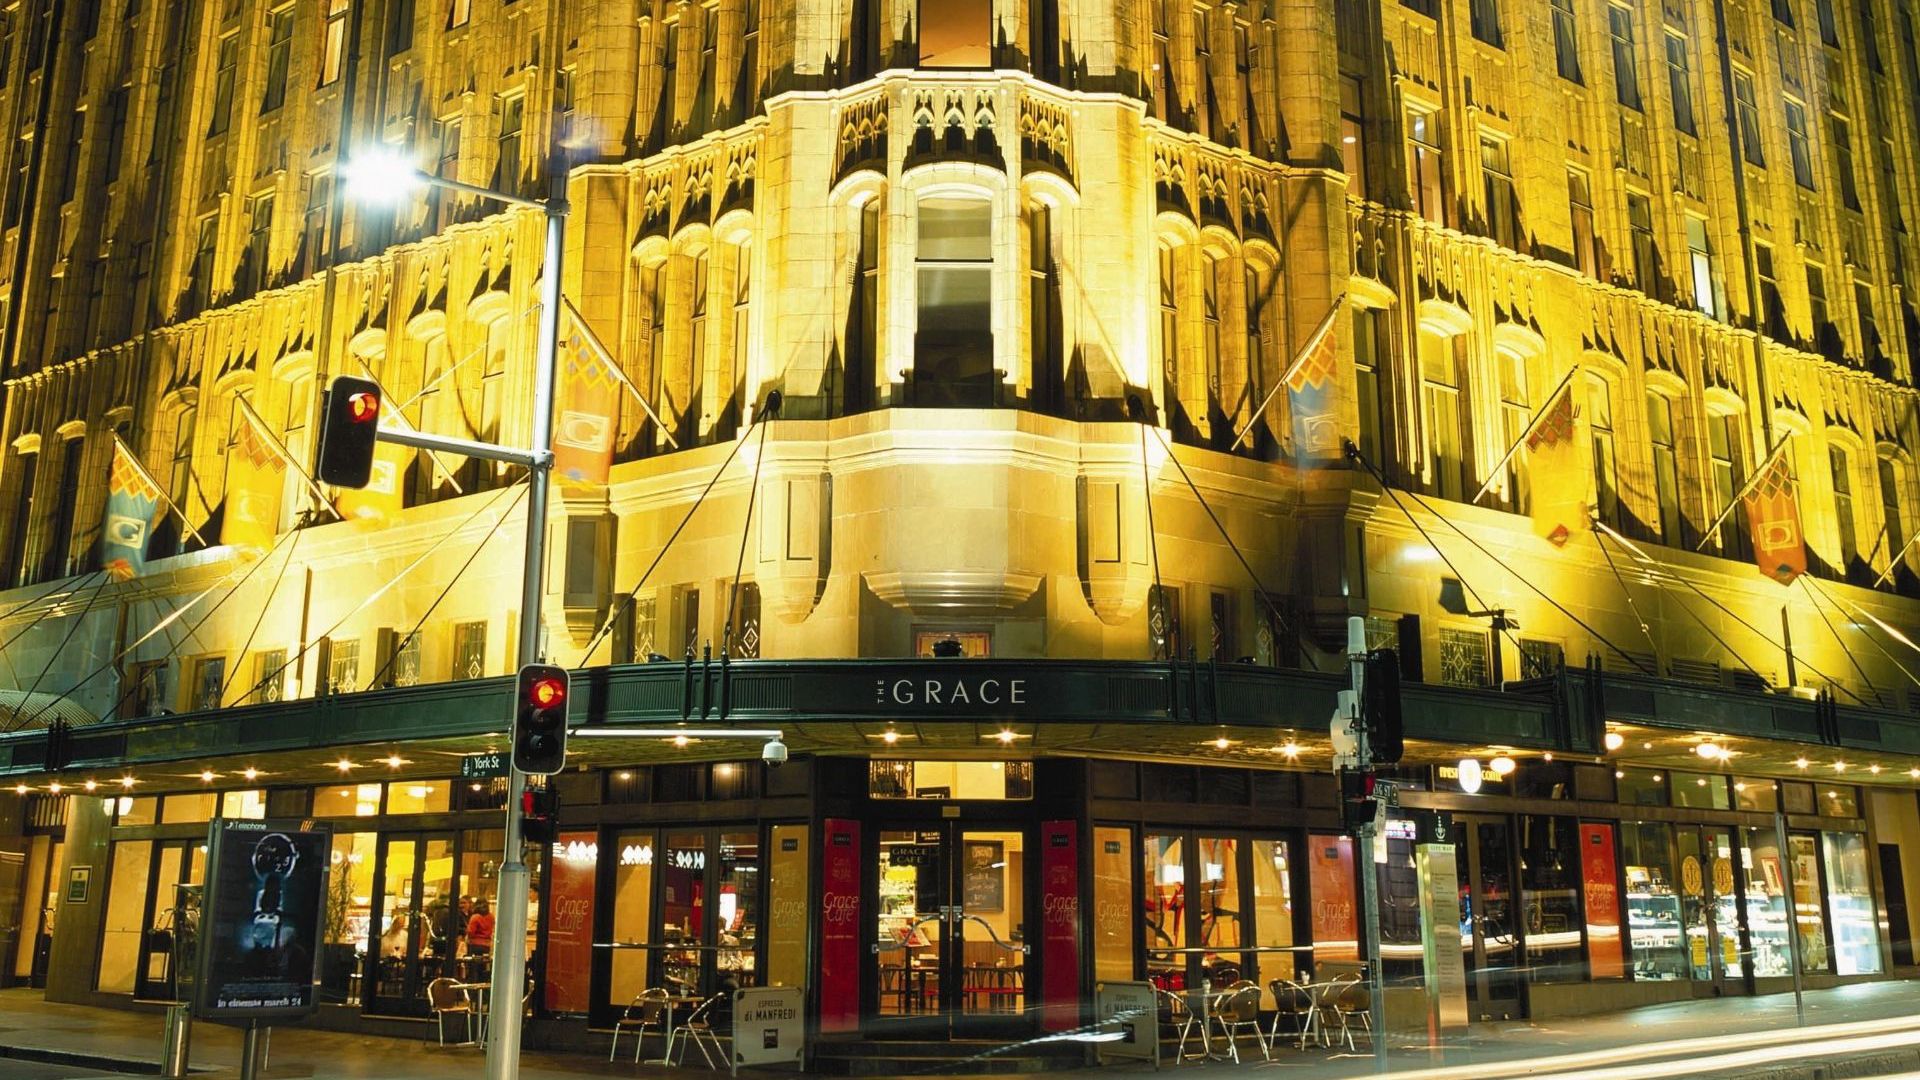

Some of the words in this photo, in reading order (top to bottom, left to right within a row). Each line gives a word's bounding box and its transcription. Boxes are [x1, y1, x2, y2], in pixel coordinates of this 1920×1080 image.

[111, 521, 139, 541] G
[892, 679, 1026, 704] GRACE
[474, 756, 490, 769] York
[491, 755, 500, 768] St
[235, 821, 267, 830] Telephone
[892, 847, 928, 855] GRACE
[555, 896, 588, 919] Grace
[824, 892, 858, 913] Grace
[1043, 893, 1077, 913] Grace
[228, 998, 261, 1007] cinemas
[264, 998, 289, 1007] march
[756, 1008, 796, 1020] MANFREDI
